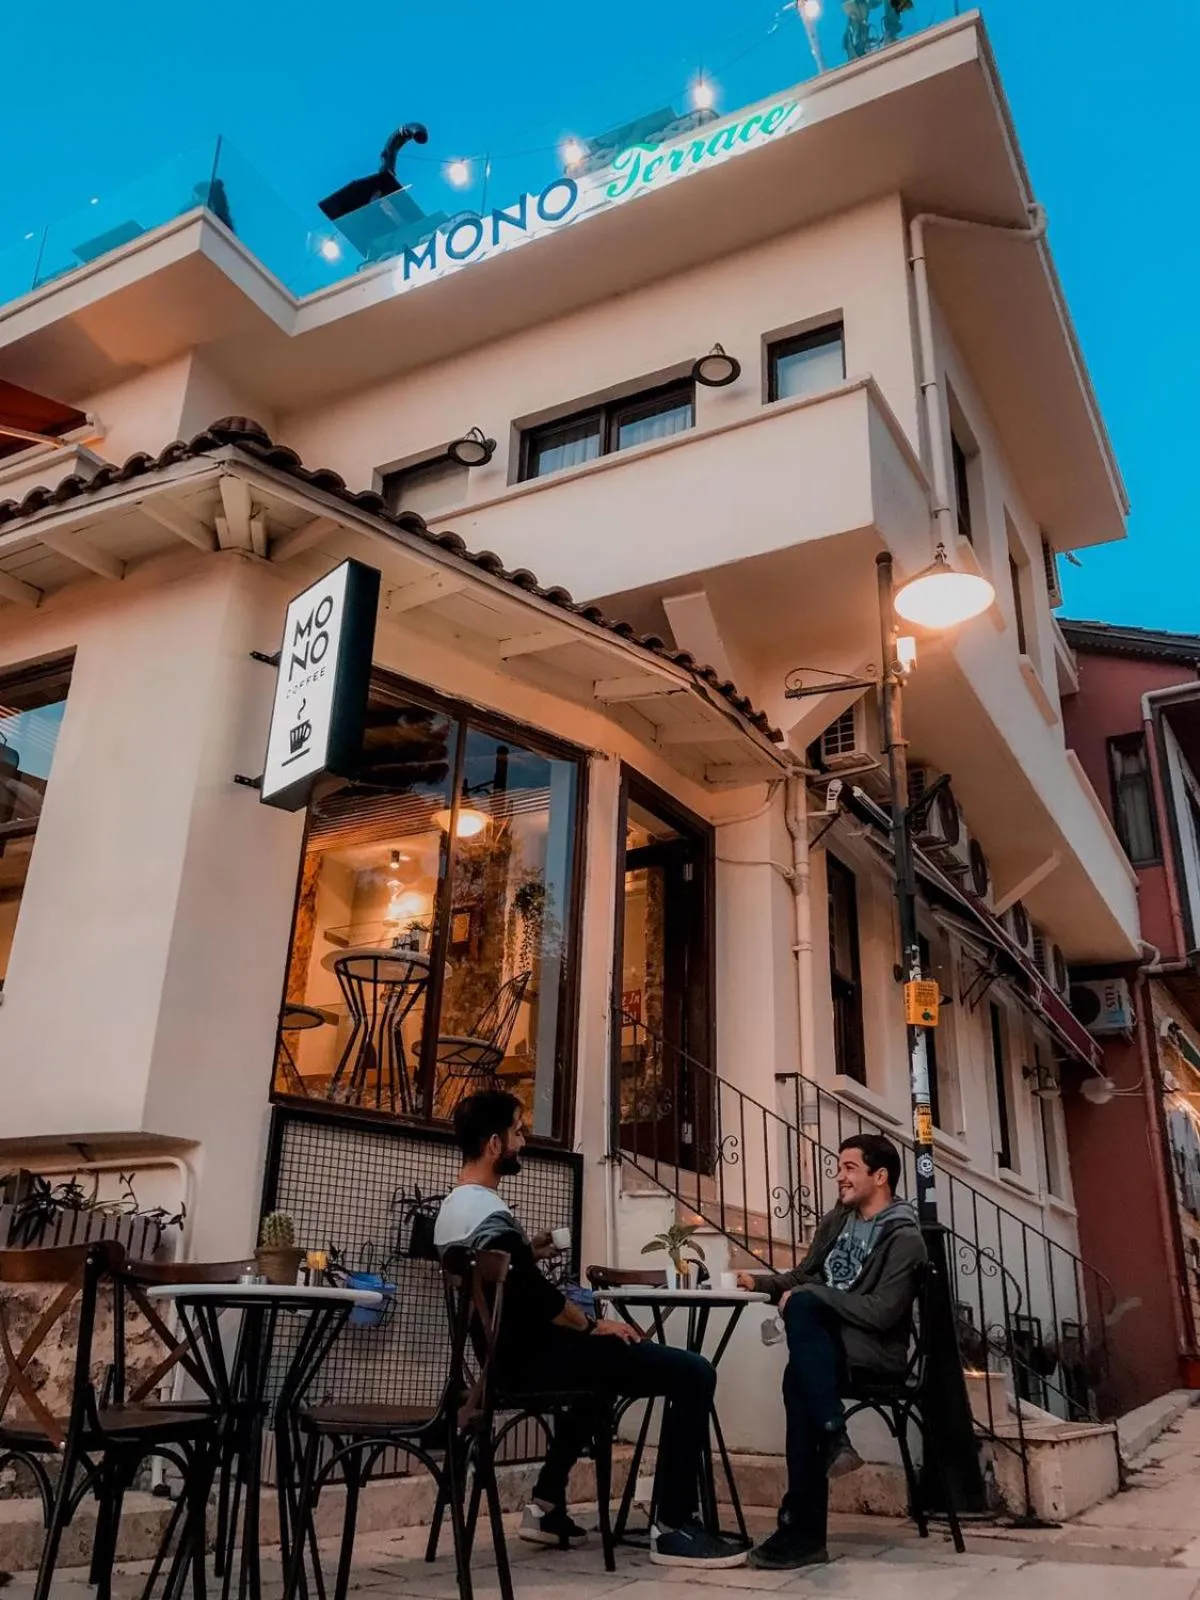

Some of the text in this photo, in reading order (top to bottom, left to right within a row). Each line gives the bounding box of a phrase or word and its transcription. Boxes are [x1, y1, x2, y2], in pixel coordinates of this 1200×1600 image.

[403, 102, 798, 280] MONO Terrace
[294, 595, 333, 646] MO
[289, 631, 328, 681] NO
